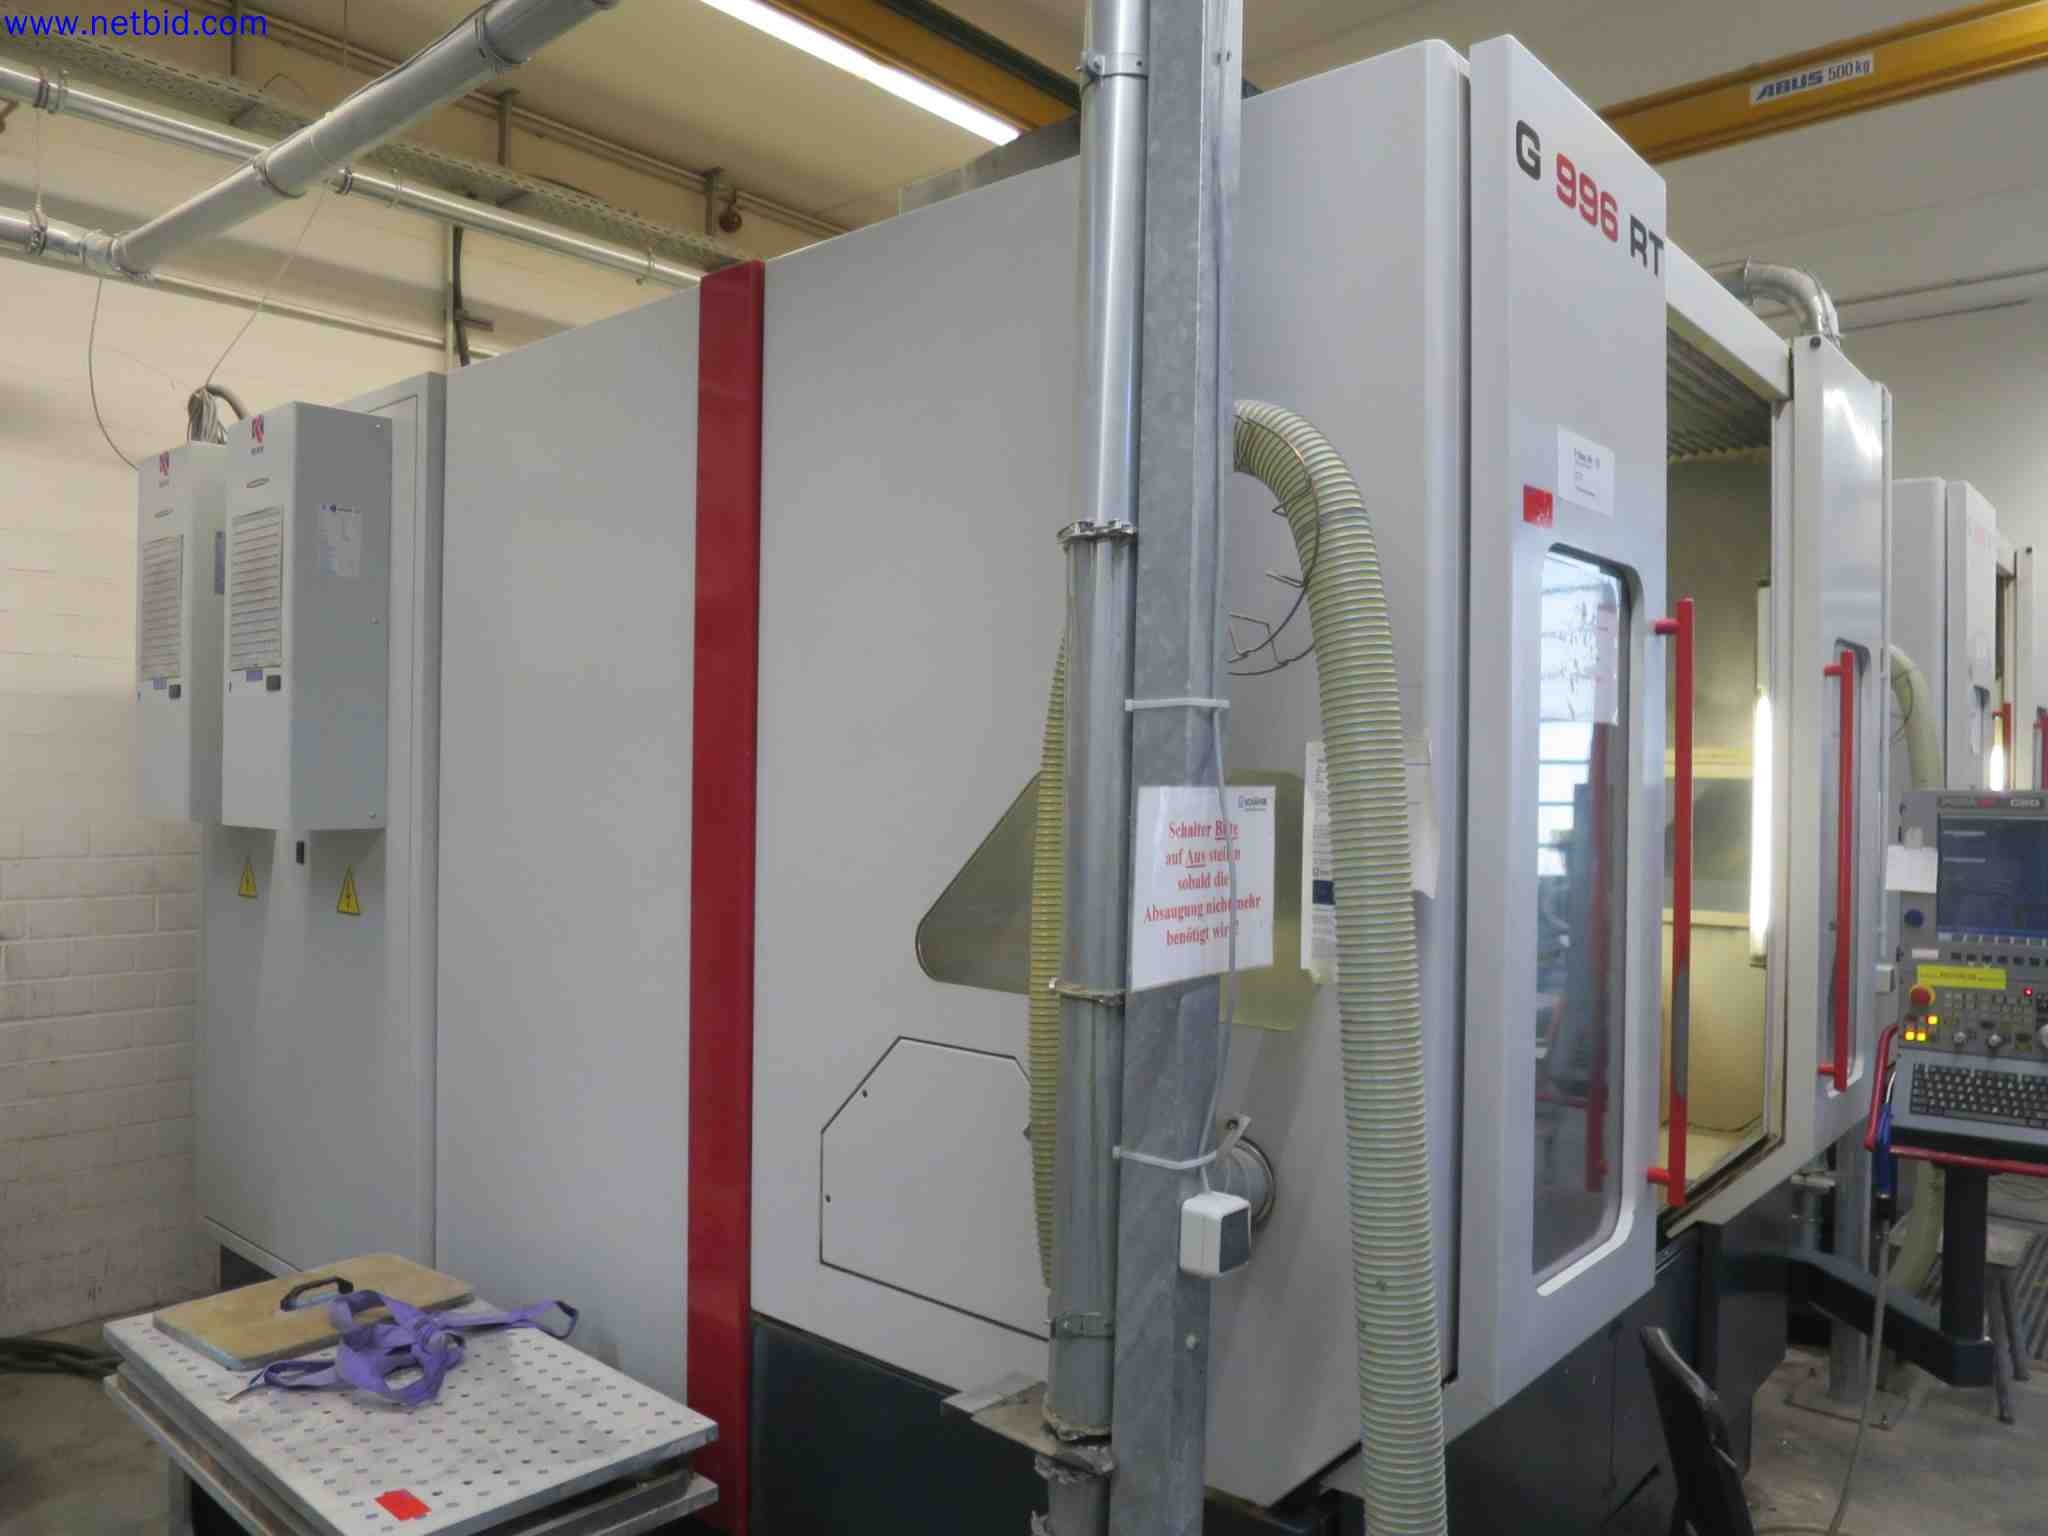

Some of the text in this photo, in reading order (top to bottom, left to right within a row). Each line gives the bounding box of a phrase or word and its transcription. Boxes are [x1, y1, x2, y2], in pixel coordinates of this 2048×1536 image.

[1755, 70, 1824, 101] ABUS
[1828, 62, 1853, 81] 500
[1516, 119, 1665, 278] G 996 RT
[1168, 821, 1212, 839] Schalter
[1166, 847, 1184, 865] auf
[1177, 872, 1211, 891] sobald
[1144, 902, 1204, 924] Absaugung
[1167, 926, 1208, 946] benötigt
